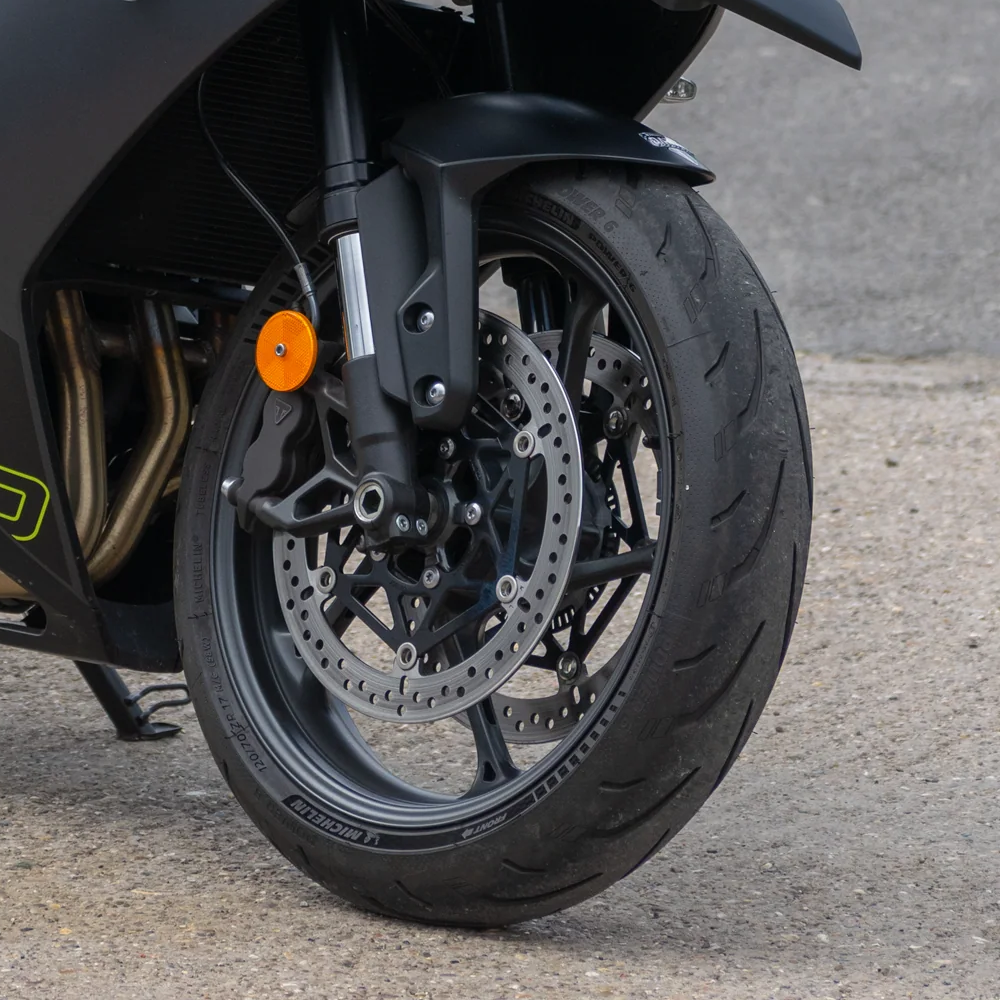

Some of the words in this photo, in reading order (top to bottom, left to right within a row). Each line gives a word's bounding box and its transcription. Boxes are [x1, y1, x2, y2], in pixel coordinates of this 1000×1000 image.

[236, 733, 267, 774] 120/70
[290, 800, 363, 841] MICHELIN
[473, 812, 508, 835] FRONT
